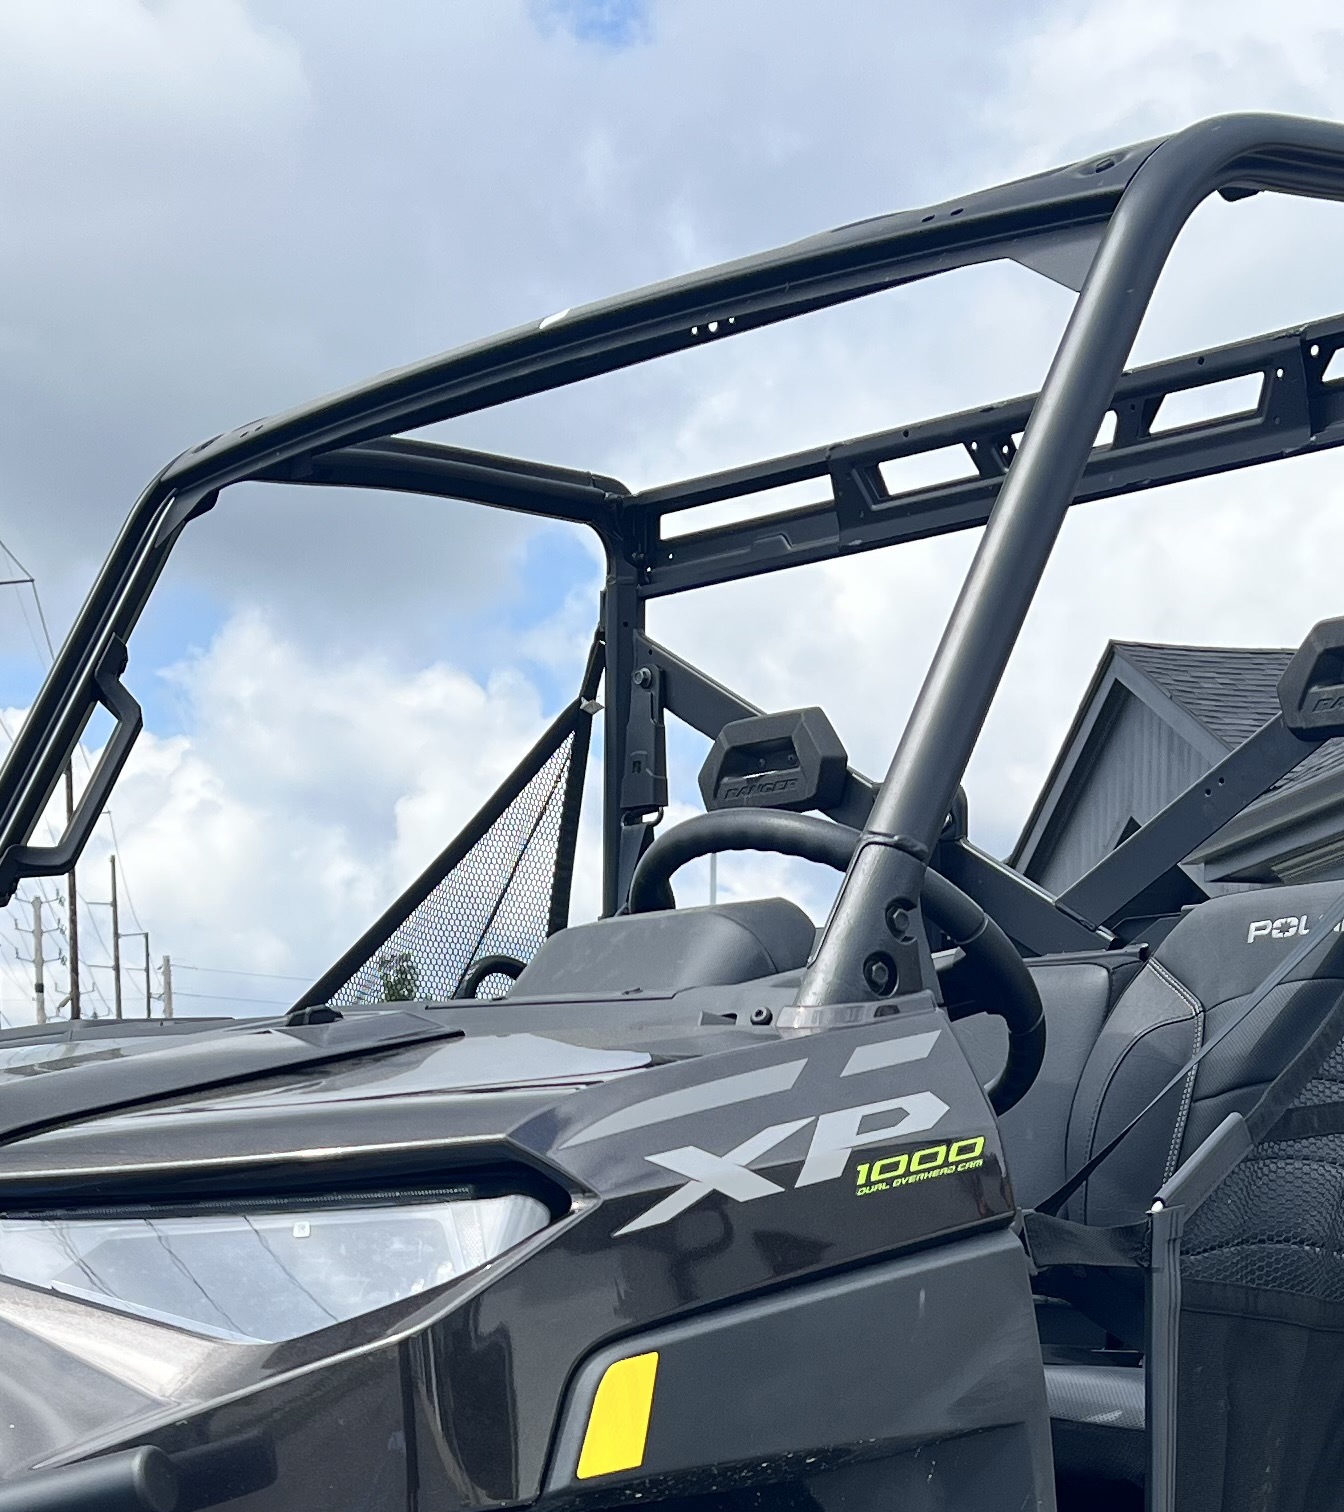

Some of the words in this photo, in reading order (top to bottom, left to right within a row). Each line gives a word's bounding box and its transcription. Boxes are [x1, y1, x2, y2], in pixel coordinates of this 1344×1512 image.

[612, 1091, 950, 1239] XP
[856, 1135, 986, 1186] 1000
[856, 1182, 890, 1197] DUAL
[892, 1165, 957, 1188] OVERHEAD
[957, 1158, 984, 1172] CAM
